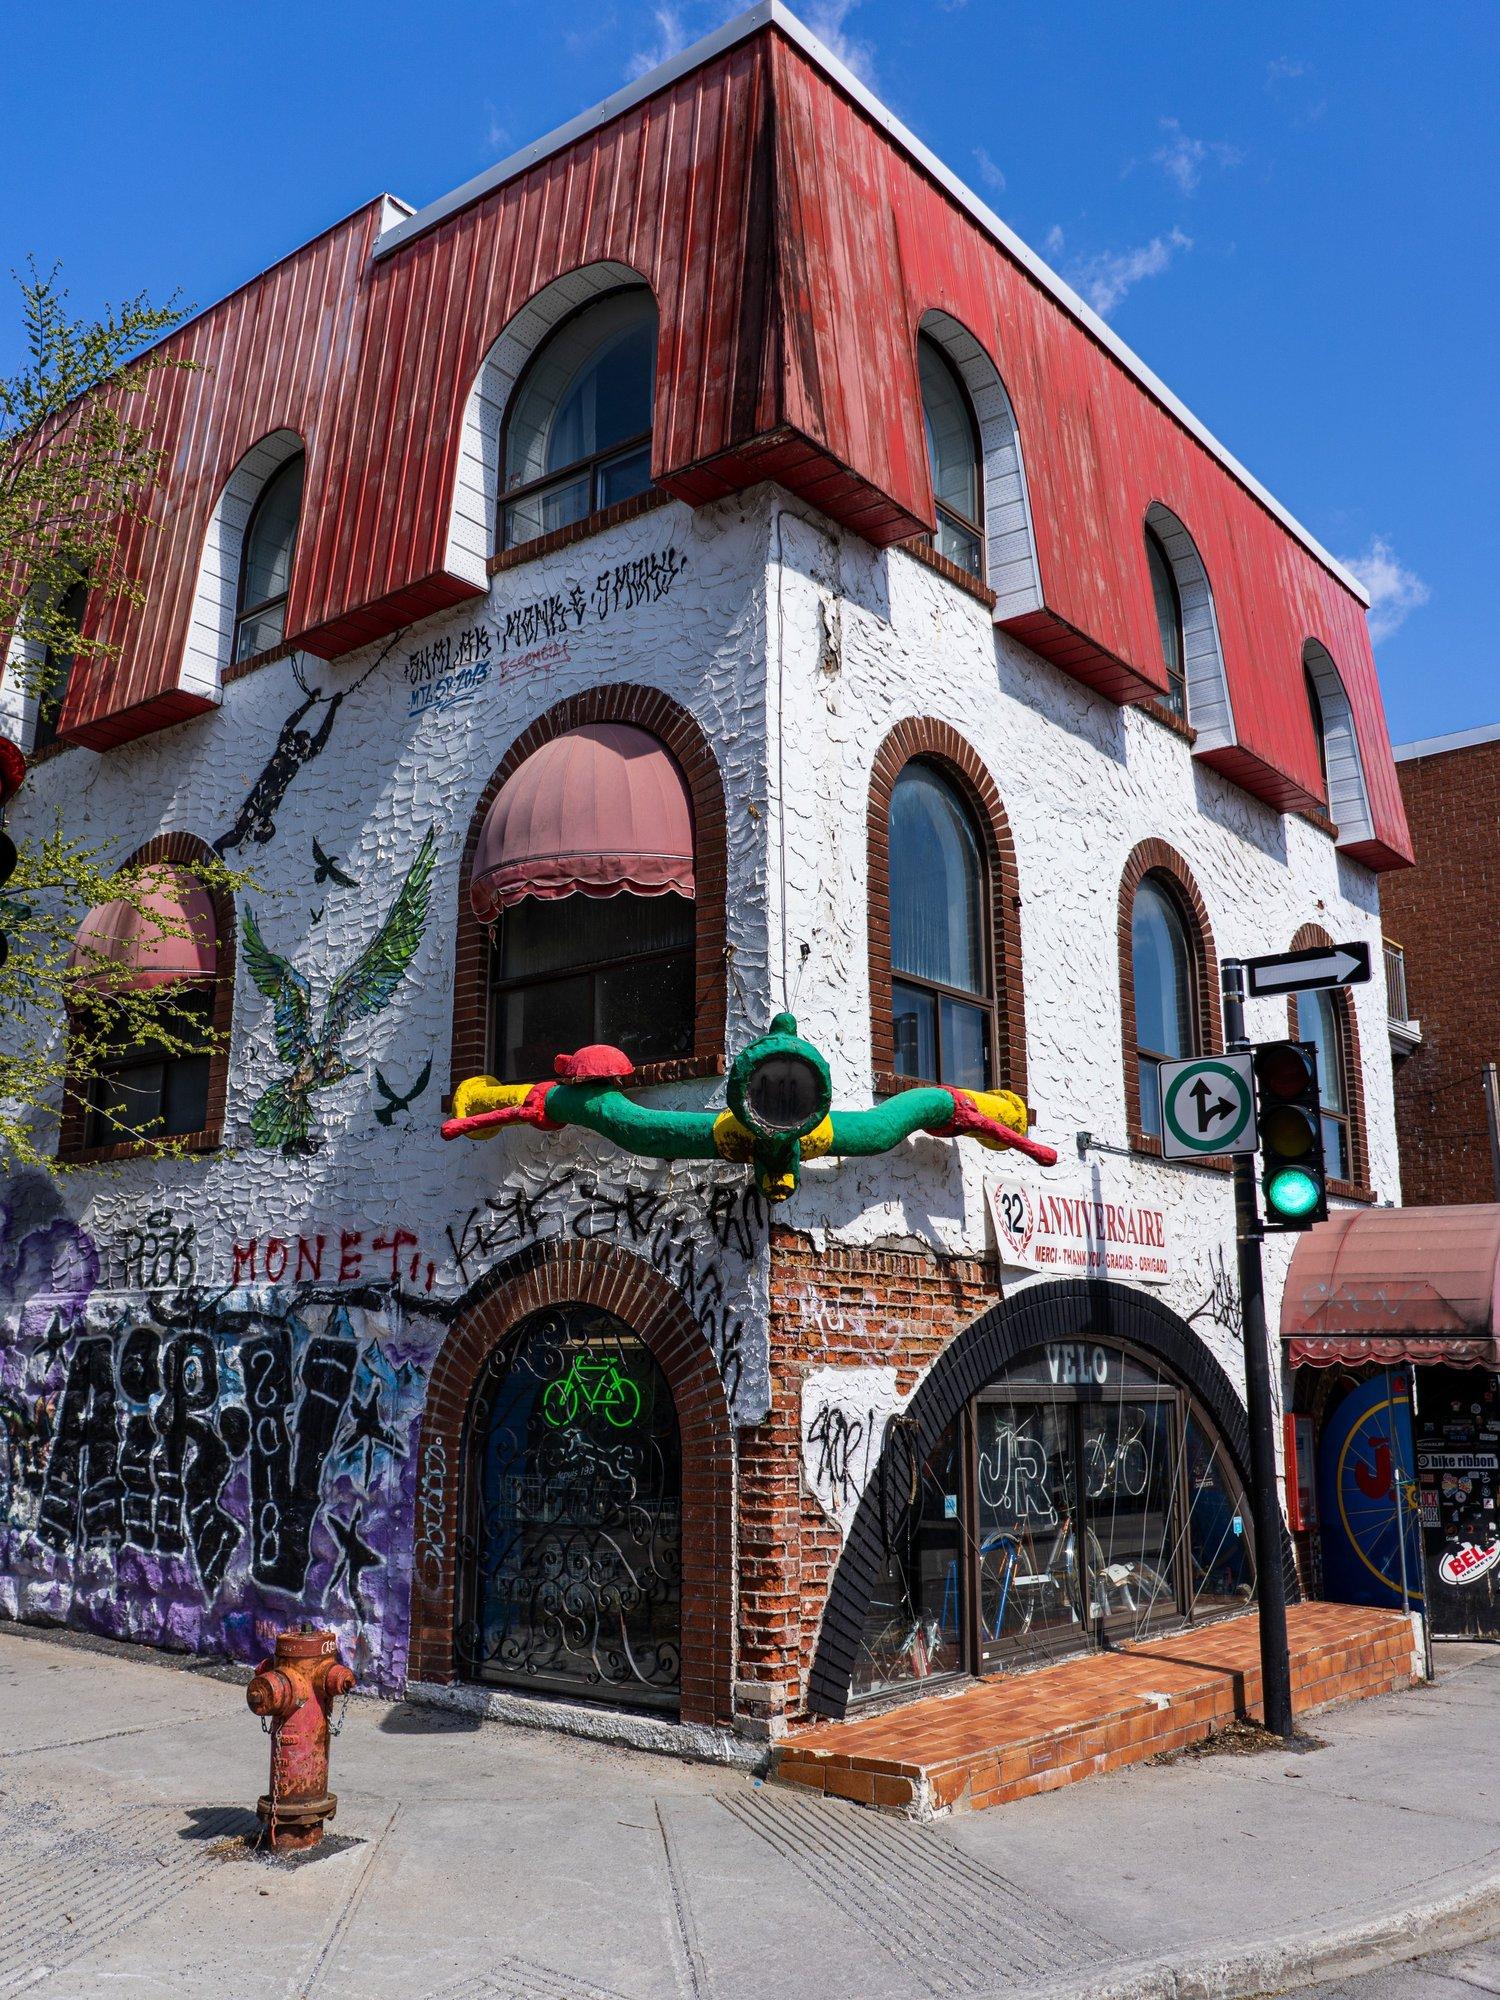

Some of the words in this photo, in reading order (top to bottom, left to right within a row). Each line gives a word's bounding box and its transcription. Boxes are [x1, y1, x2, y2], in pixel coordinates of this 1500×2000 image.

[1001, 1193, 1025, 1234] 32
[1037, 1194, 1165, 1248] ANNIVERSAIRE
[1035, 1245, 1058, 1263] MERCI
[1063, 1248, 1087, 1266] THANK
[1088, 1251, 1100, 1268] YOU
[1106, 1252, 1133, 1271] GRACIAS
[1139, 1257, 1168, 1274] OBRIGADO
[1045, 1344, 1108, 1384] VELO
[1431, 1455, 1455, 1468] bike
[1458, 1455, 1495, 1468] ribbon
[1422, 1491, 1437, 1506] OCK
[1461, 1556, 1493, 1578] HELMETS
